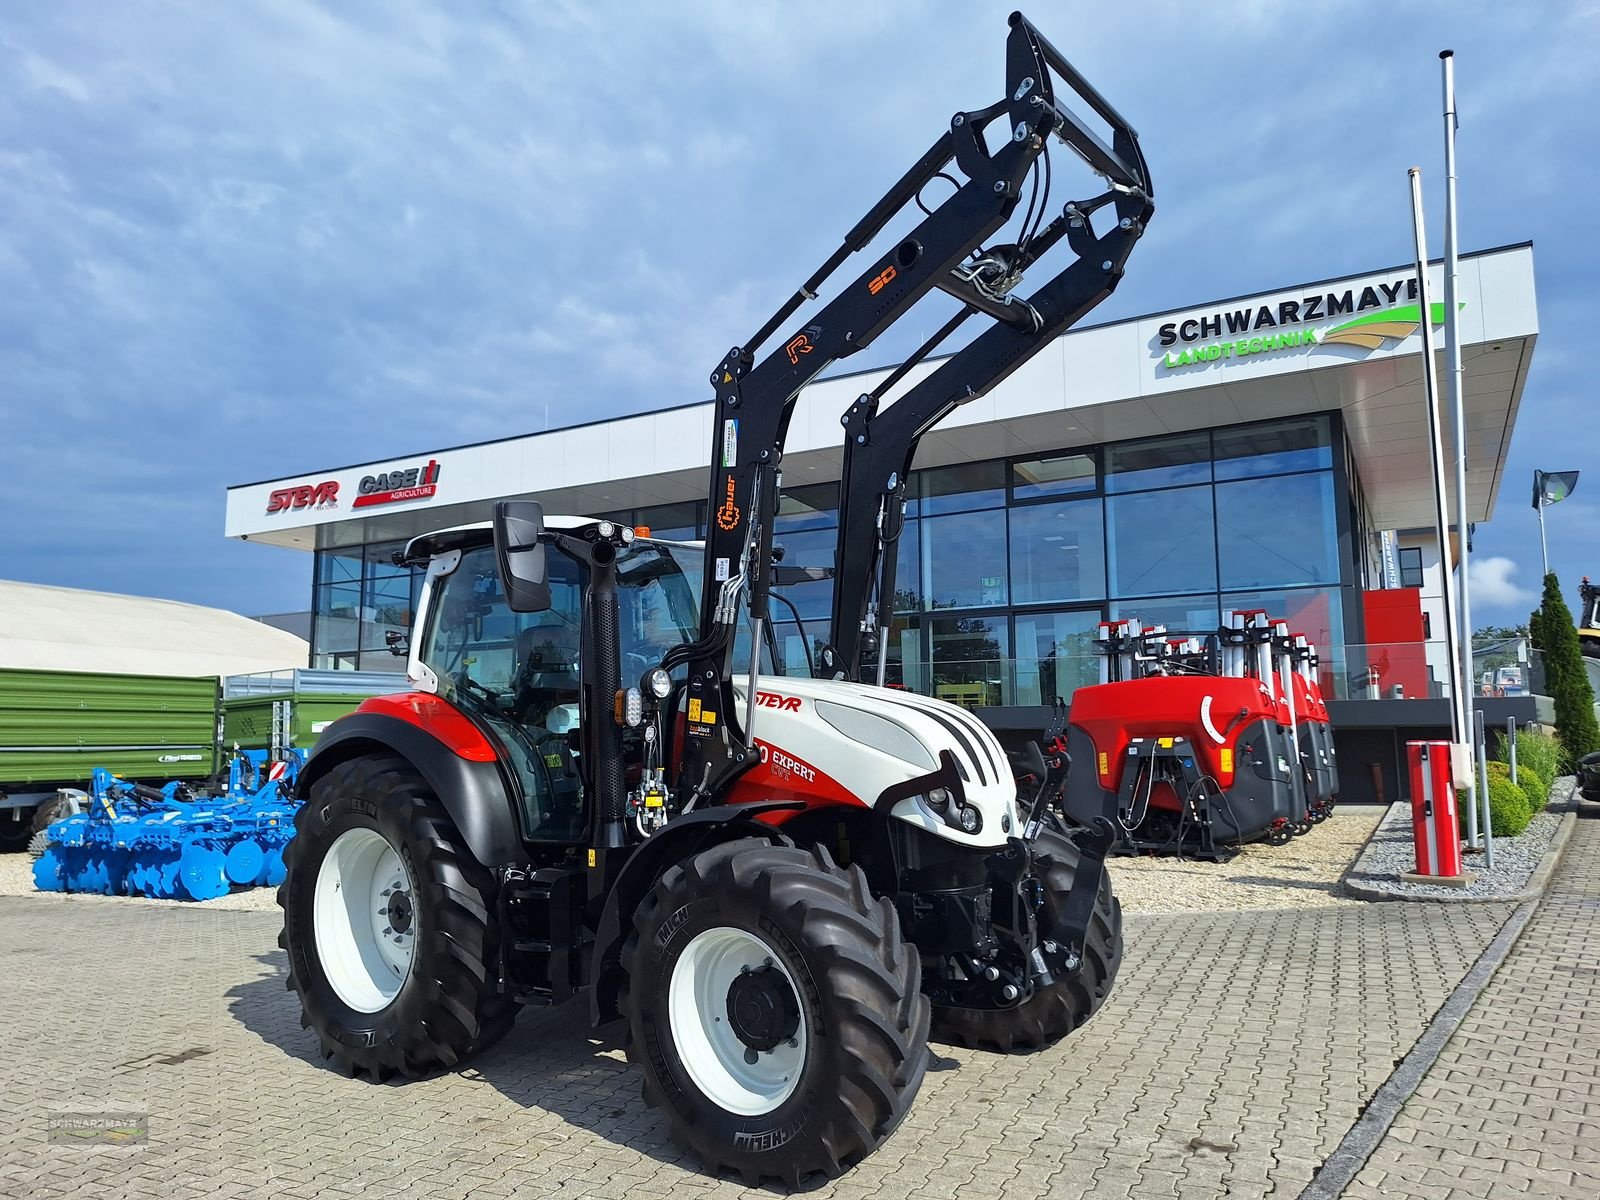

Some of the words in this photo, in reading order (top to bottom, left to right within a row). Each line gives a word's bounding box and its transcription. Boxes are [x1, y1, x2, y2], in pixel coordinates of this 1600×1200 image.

[1164, 328, 1319, 369] LANDTECHNIK
[266, 481, 340, 512] STEYR
[359, 468, 419, 495] CASE
[390, 486, 433, 500] AGRICULTURE
[722, 474, 736, 522] hauer
[1384, 530, 1398, 588] SCHWARZMA
[756, 691, 802, 713] TEYR
[772, 751, 816, 783] EXPERT
